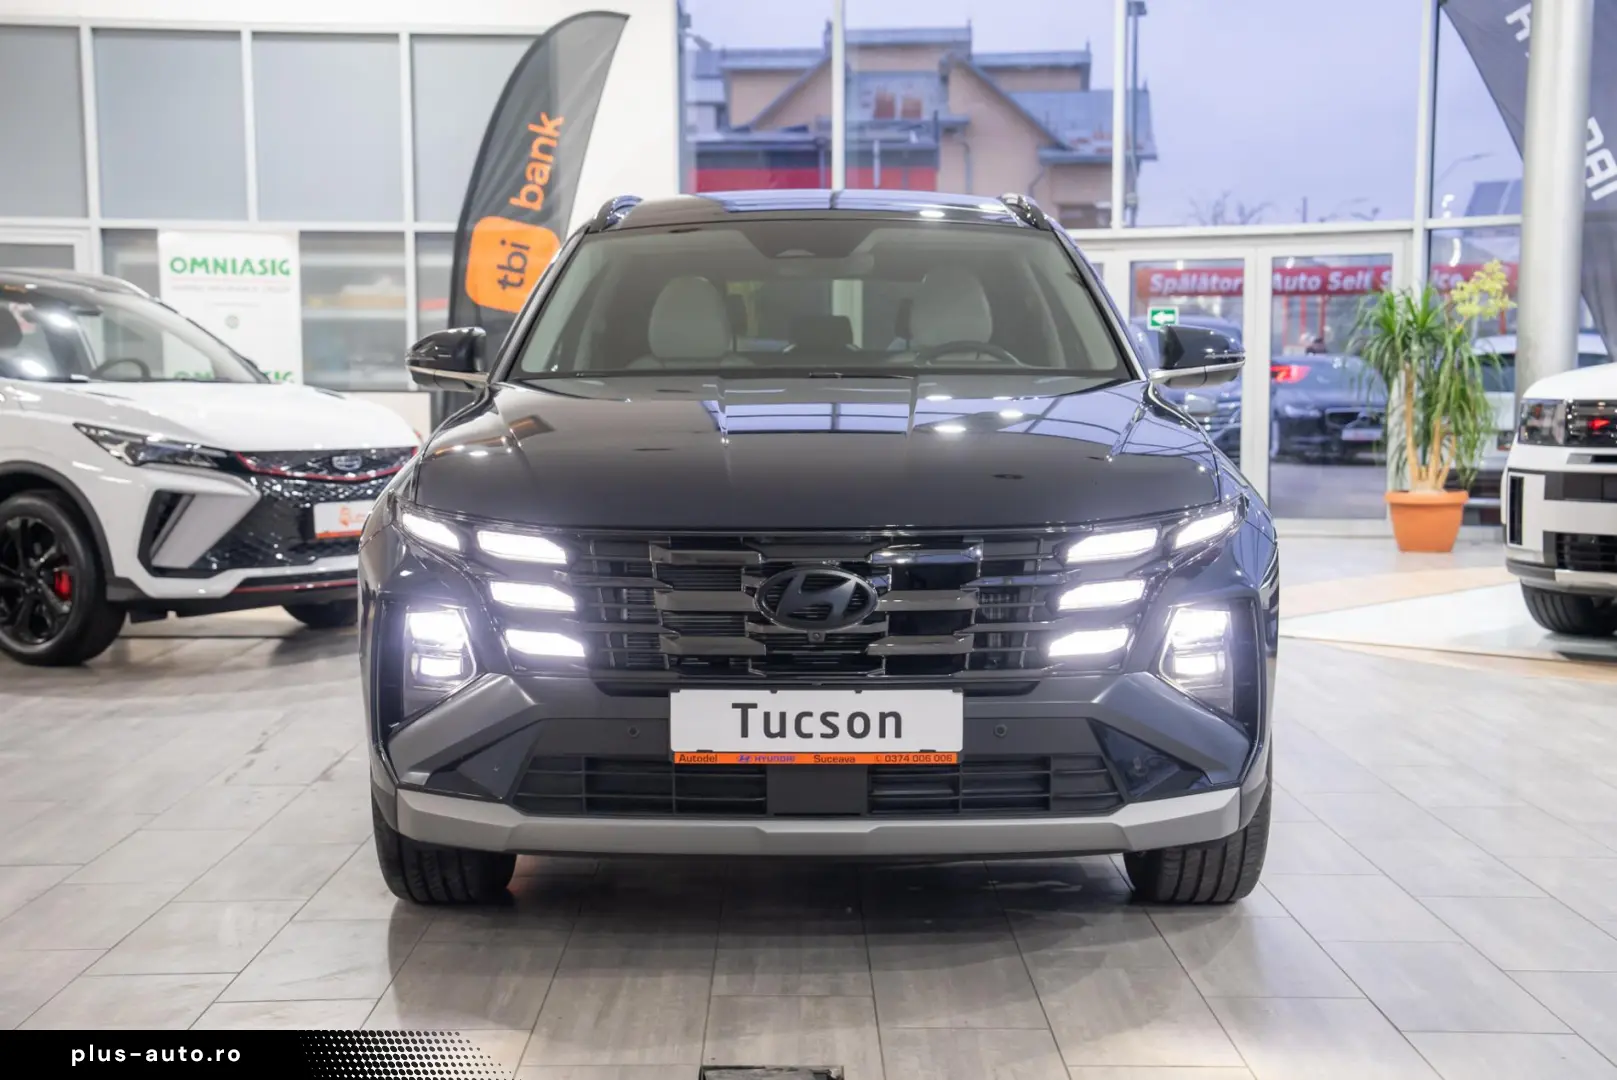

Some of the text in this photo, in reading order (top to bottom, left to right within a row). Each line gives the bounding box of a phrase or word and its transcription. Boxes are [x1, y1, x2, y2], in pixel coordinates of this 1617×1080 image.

[496, 111, 565, 291] tbi bank
[169, 256, 292, 277] OMNIASIG
[731, 702, 902, 739] Tucson
[678, 753, 718, 763] Autodel
[813, 754, 856, 764] Suceava
[884, 754, 910, 763] 0374
